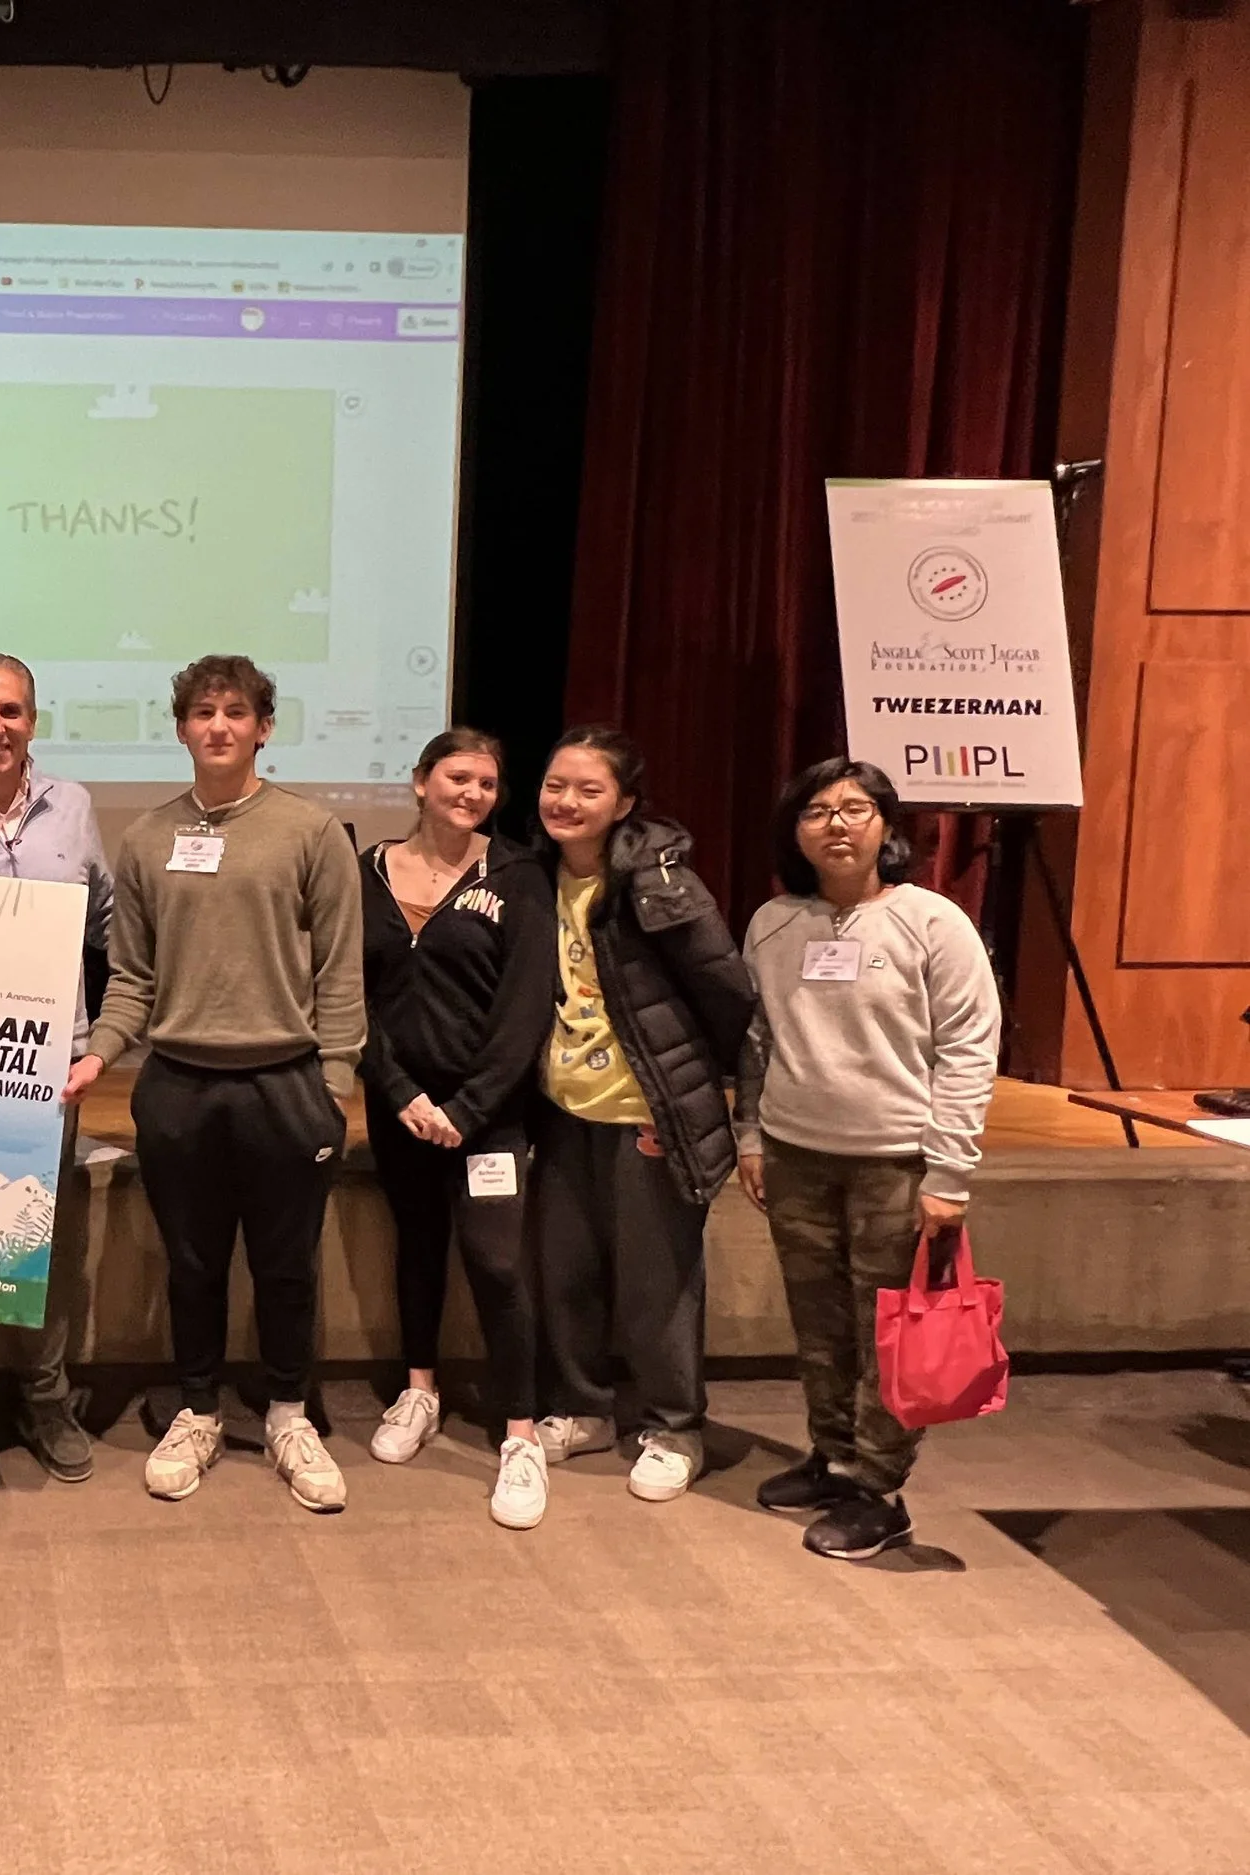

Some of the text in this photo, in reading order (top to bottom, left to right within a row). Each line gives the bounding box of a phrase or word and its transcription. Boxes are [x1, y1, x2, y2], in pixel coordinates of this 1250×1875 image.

[7, 497, 199, 543] THANKS!
[872, 697, 1042, 716] TWEEZERMAN
[453, 888, 505, 923] PINK
[6, 991, 56, 1005] Announces
